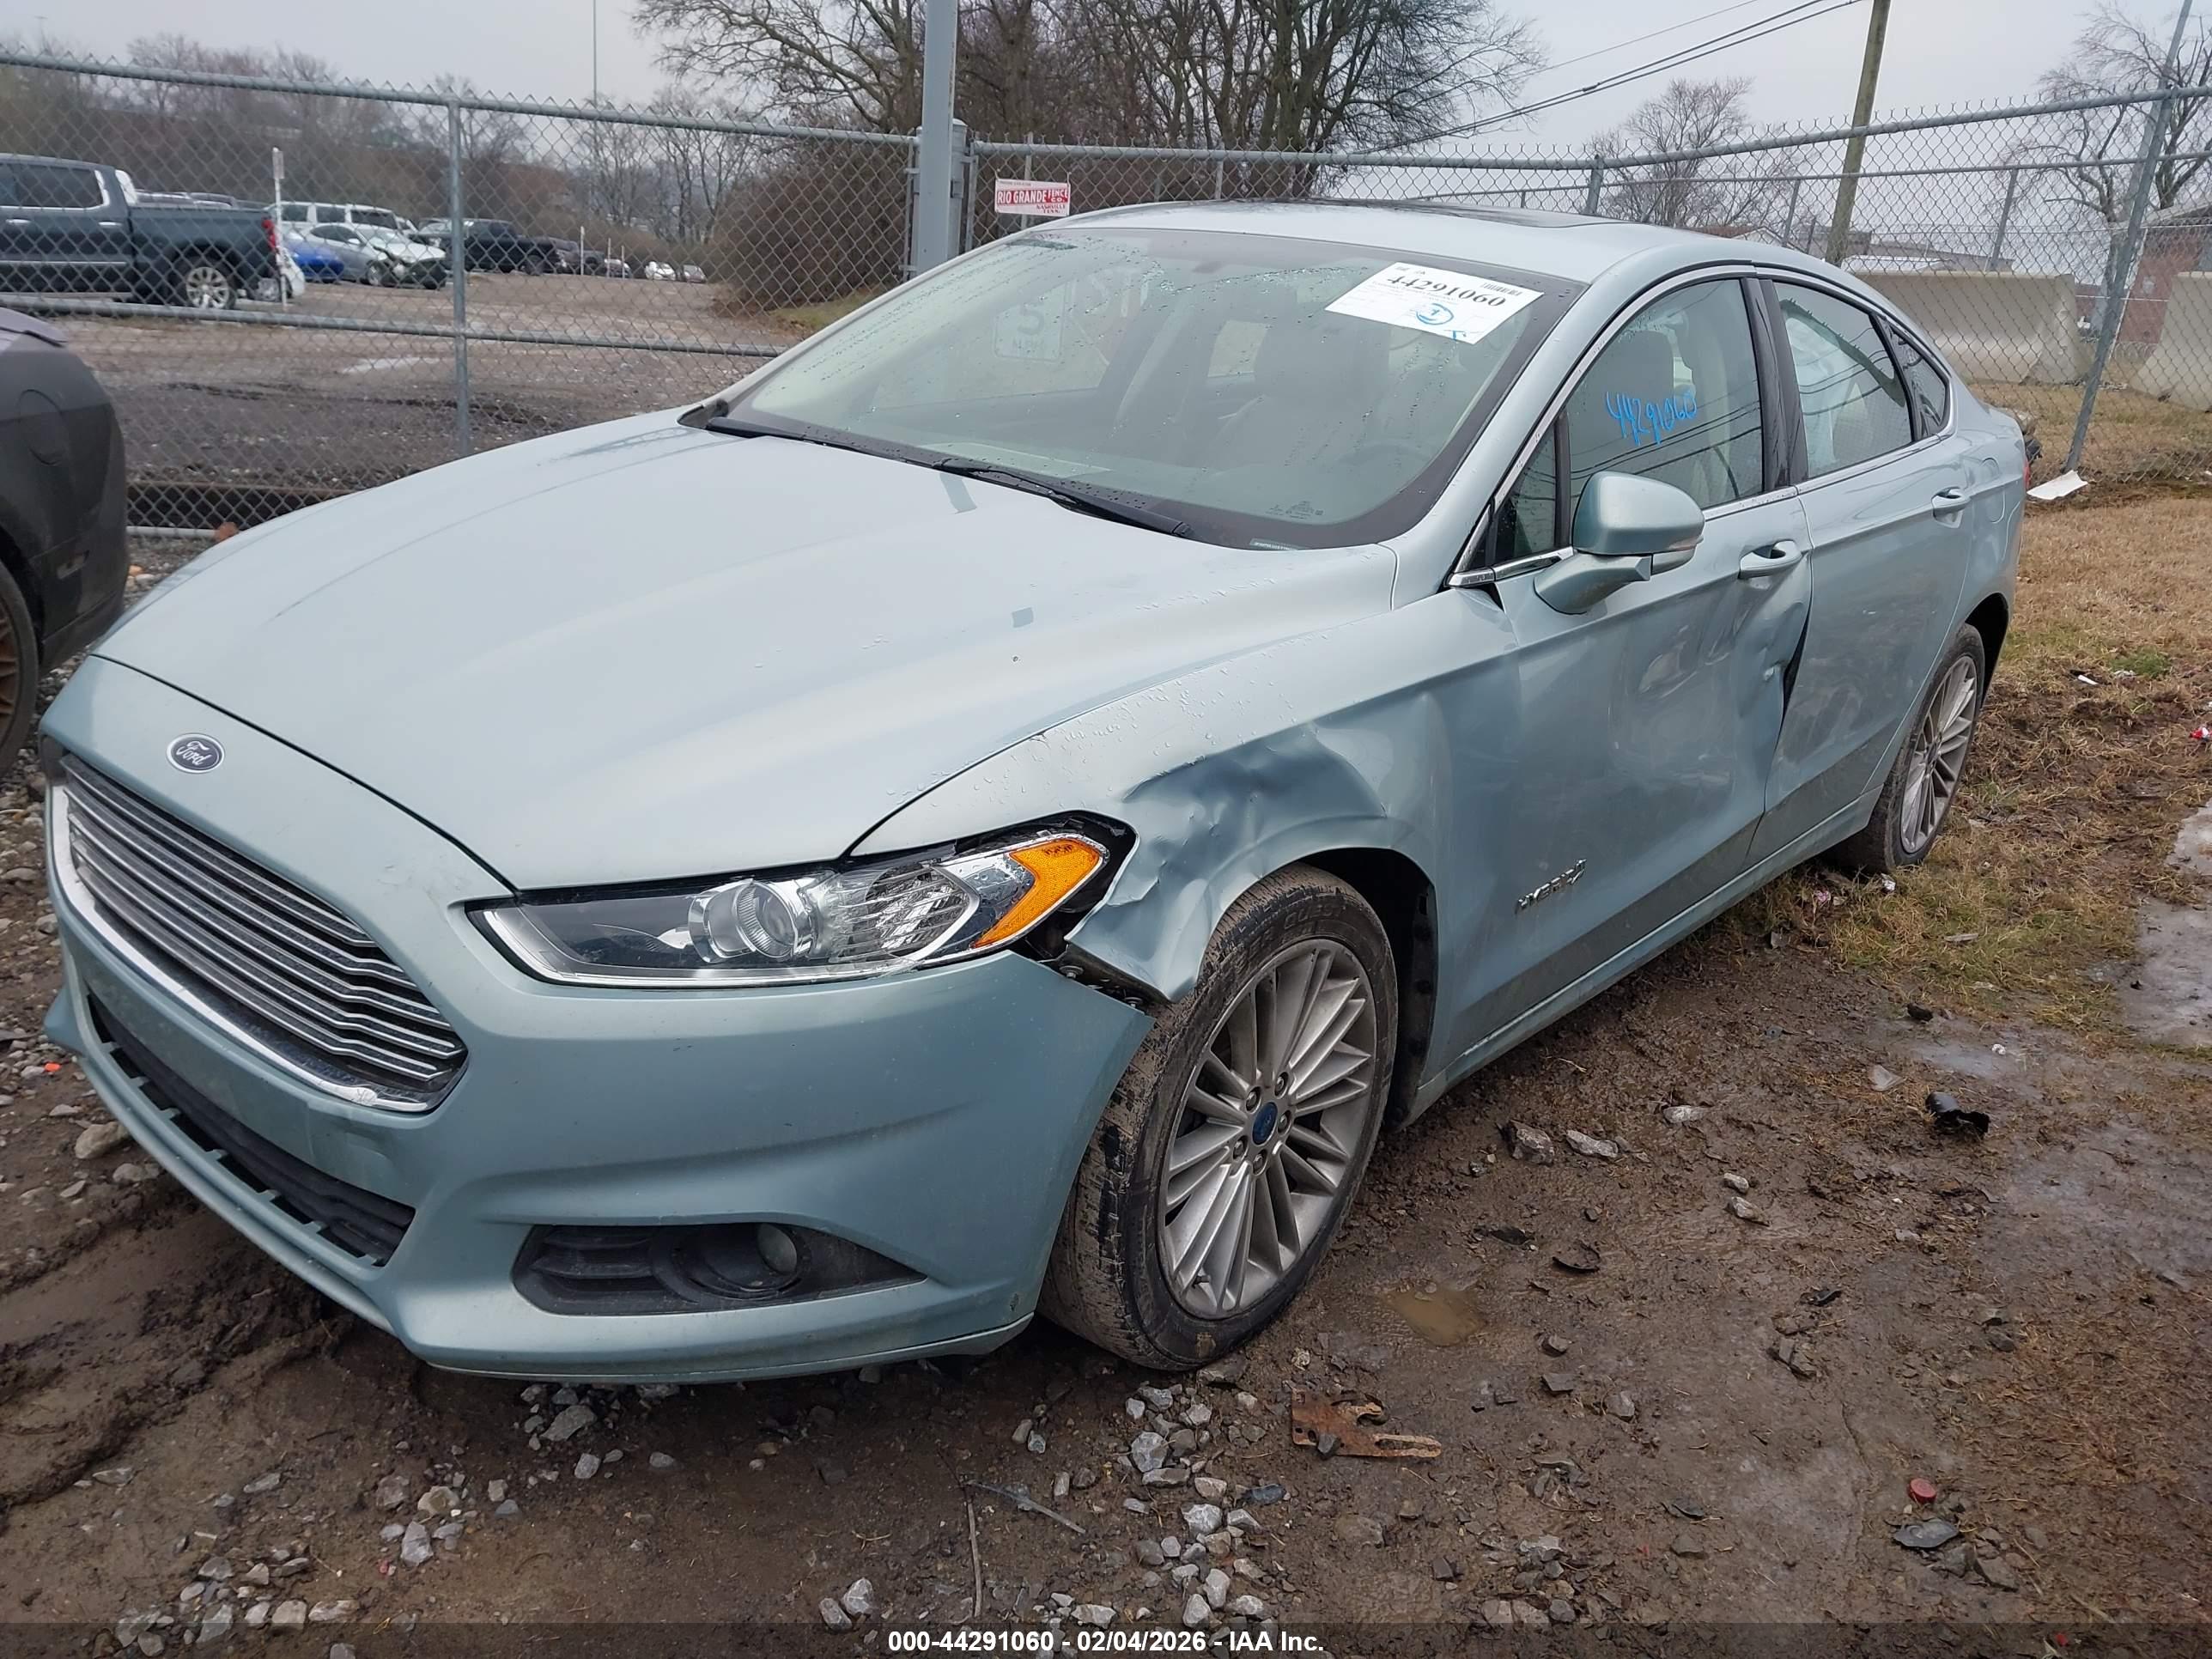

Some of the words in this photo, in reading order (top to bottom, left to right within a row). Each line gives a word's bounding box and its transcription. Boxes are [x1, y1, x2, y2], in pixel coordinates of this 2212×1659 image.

[997, 191, 1012, 204] RIO
[1013, 190, 1047, 204] GRANDE
[1048, 189, 1068, 198] FENCE
[1386, 275, 1507, 307] 44291060
[175, 740, 212, 765] Ford
